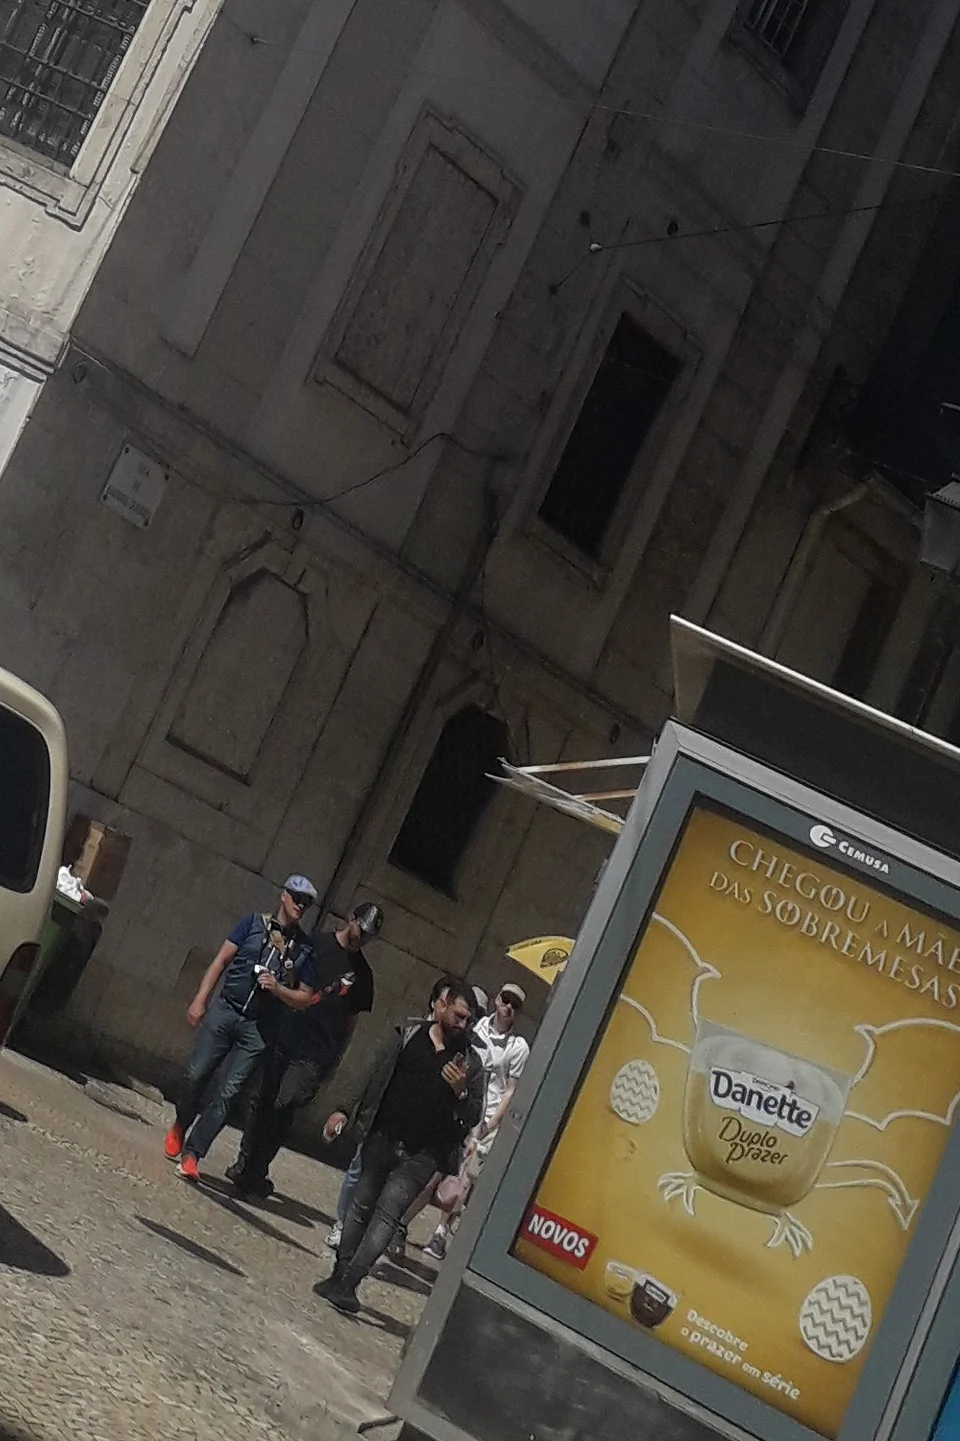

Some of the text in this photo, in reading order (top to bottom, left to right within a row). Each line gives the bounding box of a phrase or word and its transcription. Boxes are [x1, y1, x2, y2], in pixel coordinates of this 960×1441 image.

[838, 840, 890, 874] CEMUSA
[729, 840, 870, 923] CHEGOU
[709, 871, 960, 1009] DAS SOBREMESAS
[712, 1070, 813, 1129] Danette
[717, 1116, 778, 1148] Duplo
[725, 1142, 788, 1165] Prazer
[528, 1214, 591, 1259] NOVOS
[686, 1309, 748, 1352] Descobre
[690, 1330, 742, 1367] prazer
[741, 1362, 761, 1379] em
[761, 1372, 801, 1401] série
